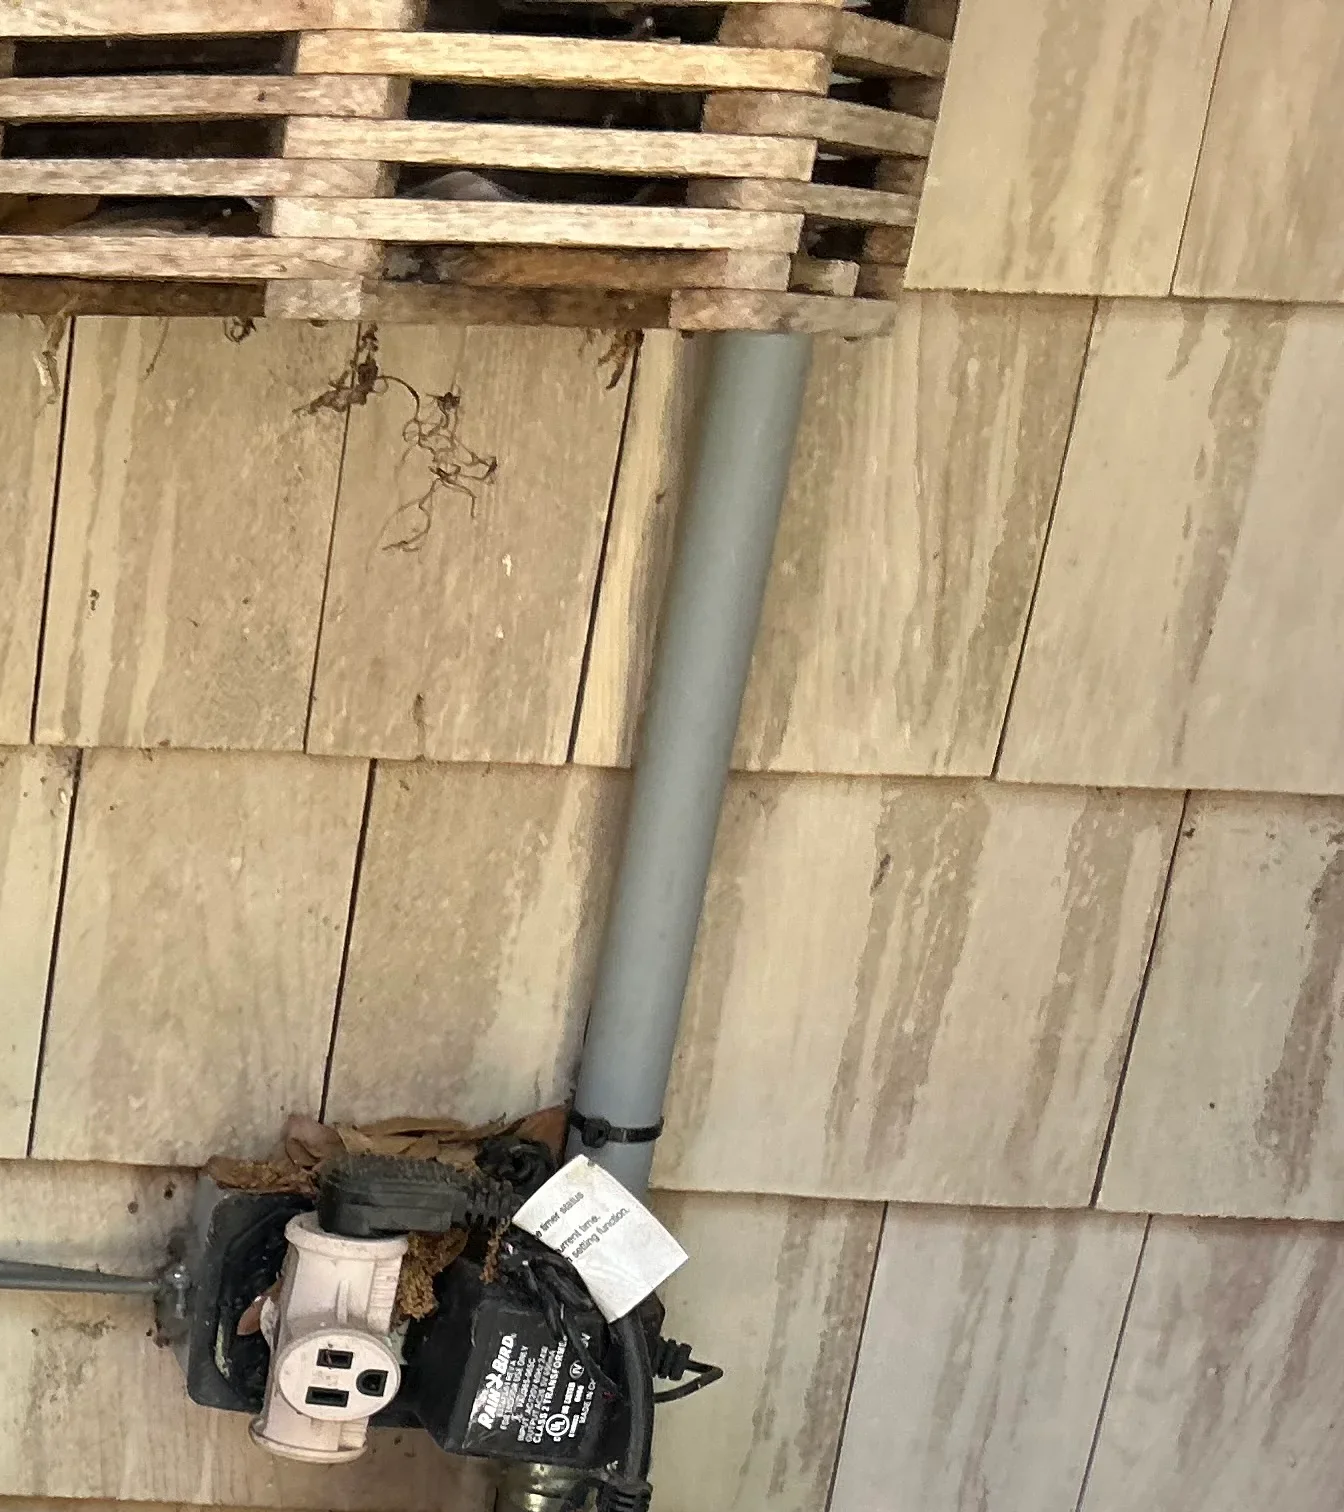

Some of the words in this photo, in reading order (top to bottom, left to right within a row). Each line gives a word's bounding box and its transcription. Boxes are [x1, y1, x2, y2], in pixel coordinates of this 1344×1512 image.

[559, 1191, 585, 1214] status
[571, 1232, 601, 1259] setting
[477, 1387, 501, 1430] RAIN
[491, 1335, 515, 1375] BIRD
[533, 1412, 548, 1443] CLASS
